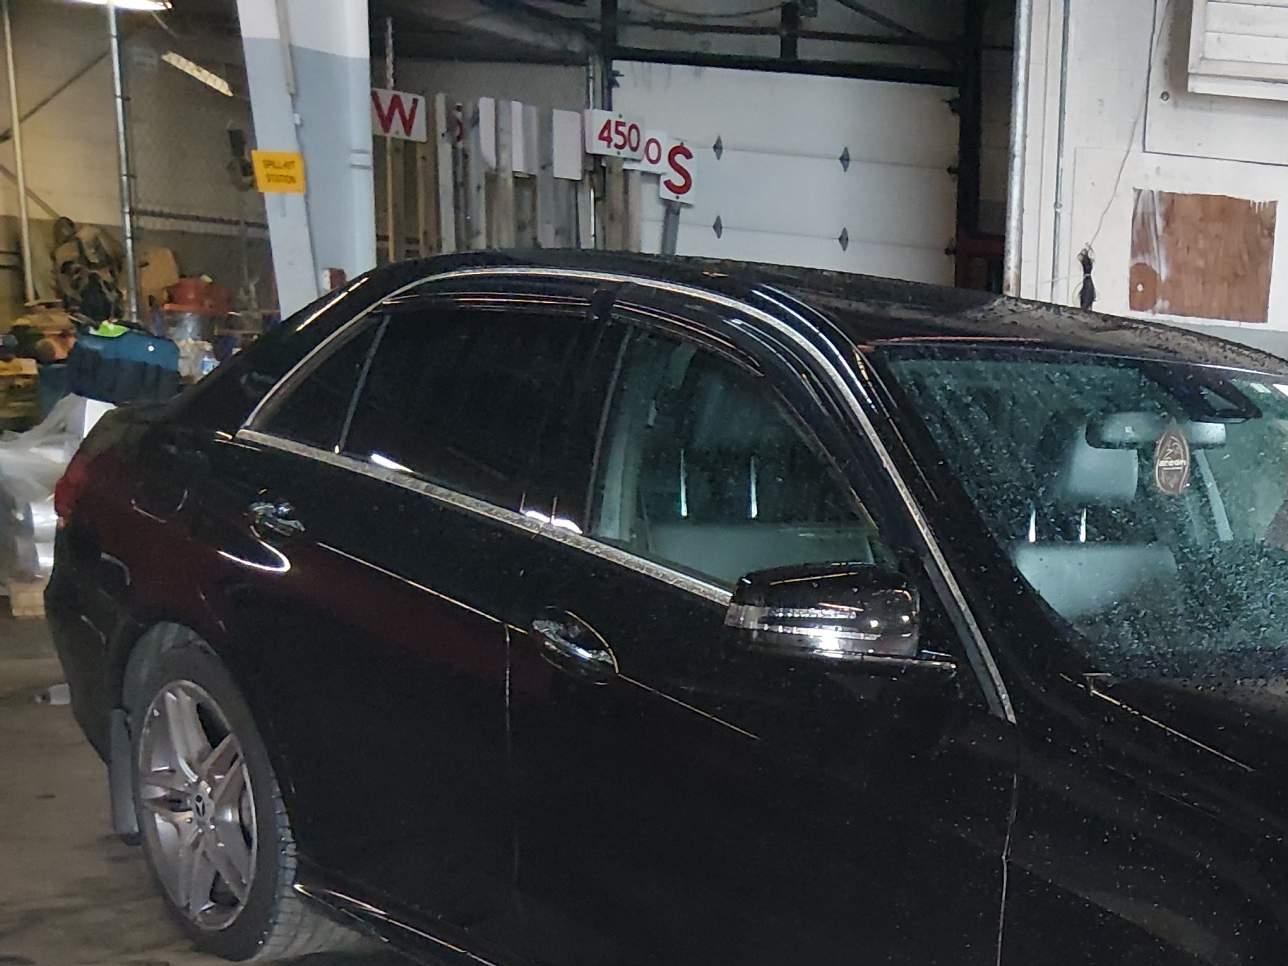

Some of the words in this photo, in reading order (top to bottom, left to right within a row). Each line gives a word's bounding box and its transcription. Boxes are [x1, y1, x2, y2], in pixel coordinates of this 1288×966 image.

[371, 90, 419, 137] W
[597, 118, 641, 153] 450
[663, 144, 694, 196] S
